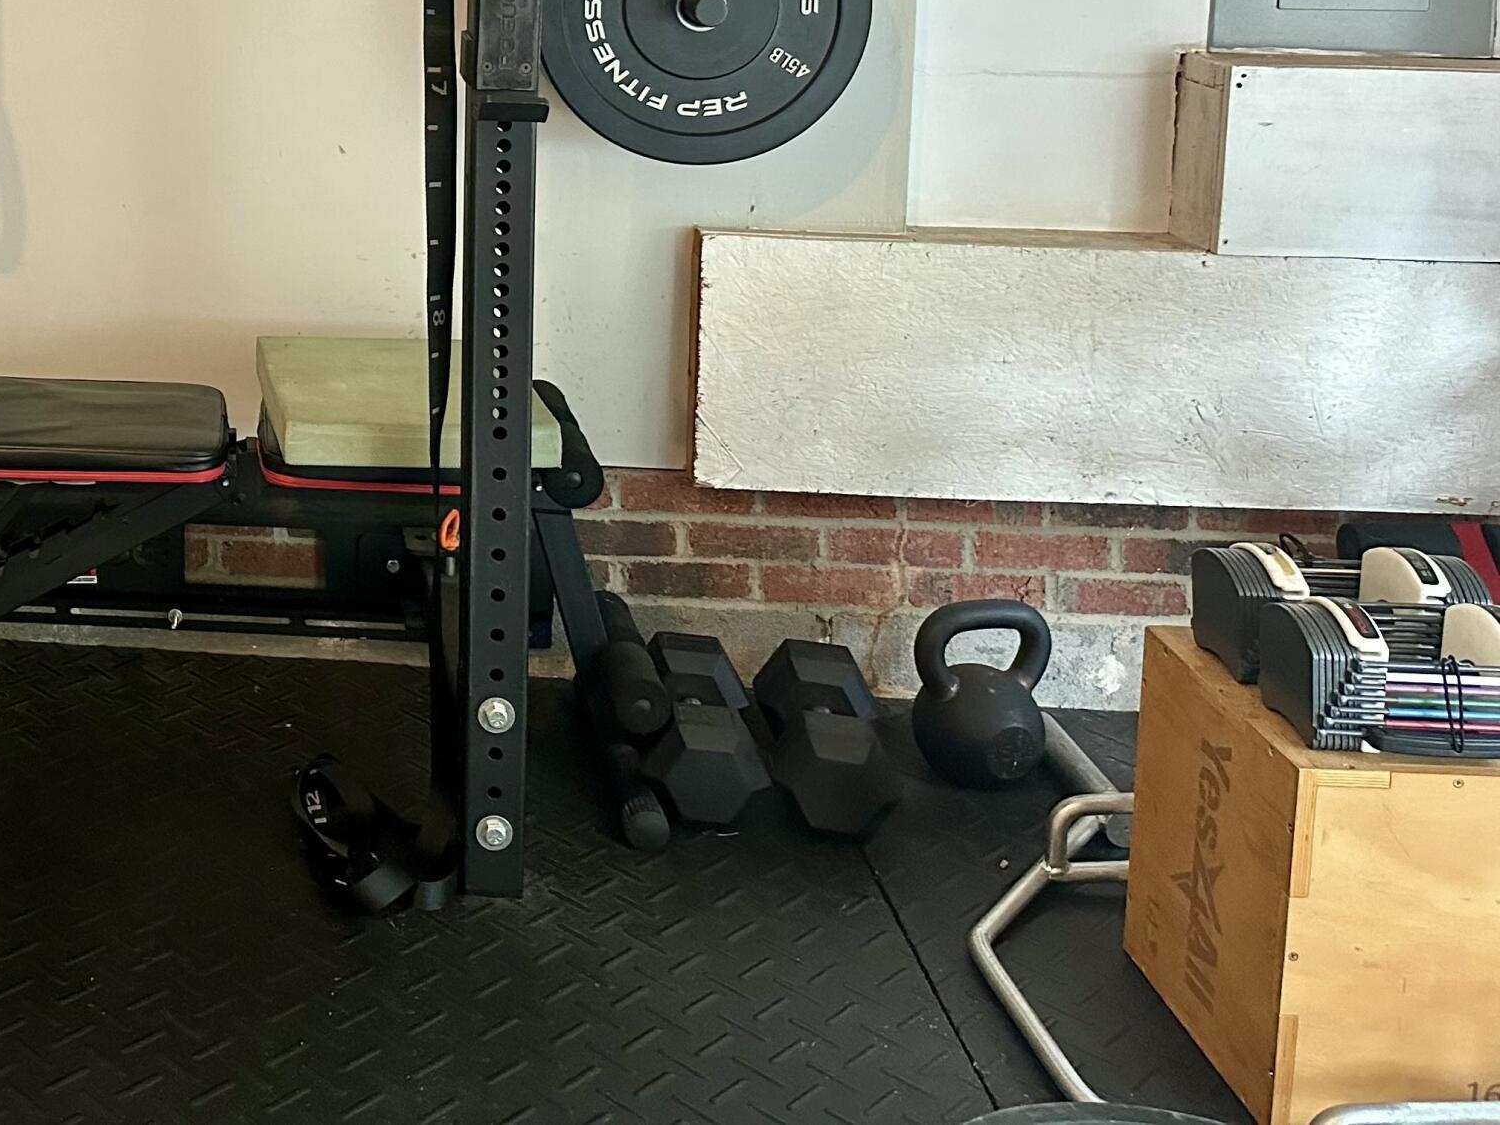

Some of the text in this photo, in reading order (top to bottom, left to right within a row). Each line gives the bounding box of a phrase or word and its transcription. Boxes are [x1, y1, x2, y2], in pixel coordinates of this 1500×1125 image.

[768, 46, 811, 78] 45LB
[676, 90, 749, 117] REP
[432, 309, 446, 327] 8
[305, 788, 322, 815] 12
